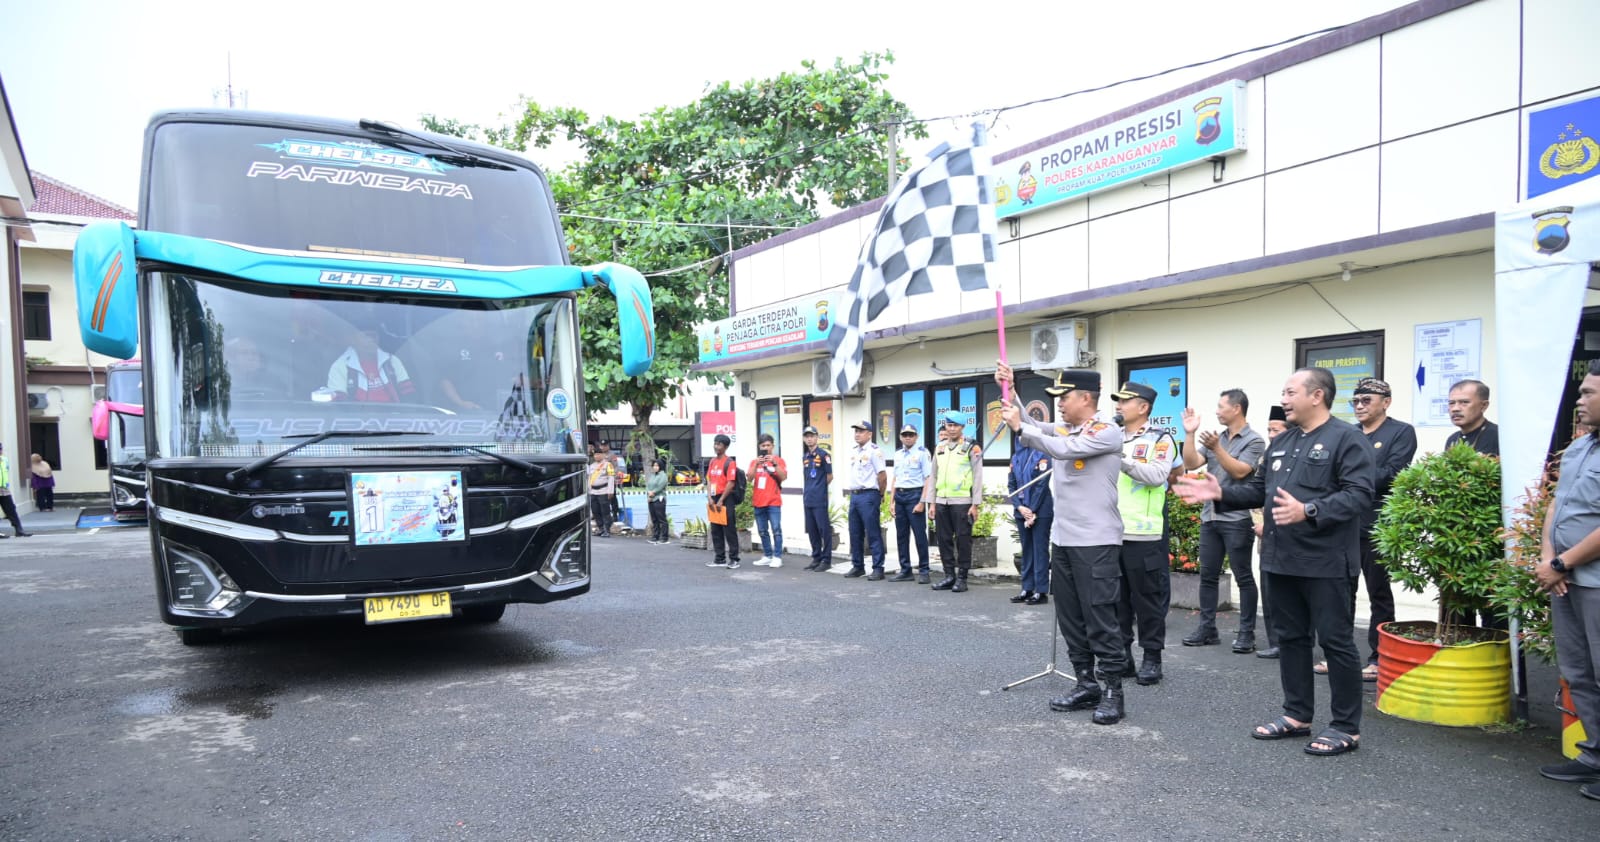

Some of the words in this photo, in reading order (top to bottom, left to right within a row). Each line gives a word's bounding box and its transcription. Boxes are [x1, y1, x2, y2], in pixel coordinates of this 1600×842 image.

[1040, 135, 1109, 172] PROPAM
[1114, 109, 1182, 148] PRESISI
[288, 143, 434, 171] CHELSEA
[1044, 167, 1083, 187] POLRES
[1086, 135, 1177, 176] KARANGANYAR
[246, 161, 474, 200] PARIWISATA
[1057, 178, 1086, 194] PROPAM
[1086, 174, 1105, 187] KUAT
[1106, 167, 1127, 180] POLRI
[1128, 156, 1162, 175] MANTAP
[319, 270, 458, 293] CHELSEA
[726, 327, 758, 342] PENJAGA
[759, 322, 782, 337] CITRA
[783, 316, 807, 331] POLRI
[732, 316, 757, 331] GARDA
[758, 306, 798, 324] TERDEPAN
[230, 418, 325, 437] BUS
[330, 418, 543, 440] PARIWISATA
[365, 505, 378, 532] 1
[367, 599, 384, 614] AD
[388, 594, 421, 611] 7490
[431, 592, 447, 607] OF
